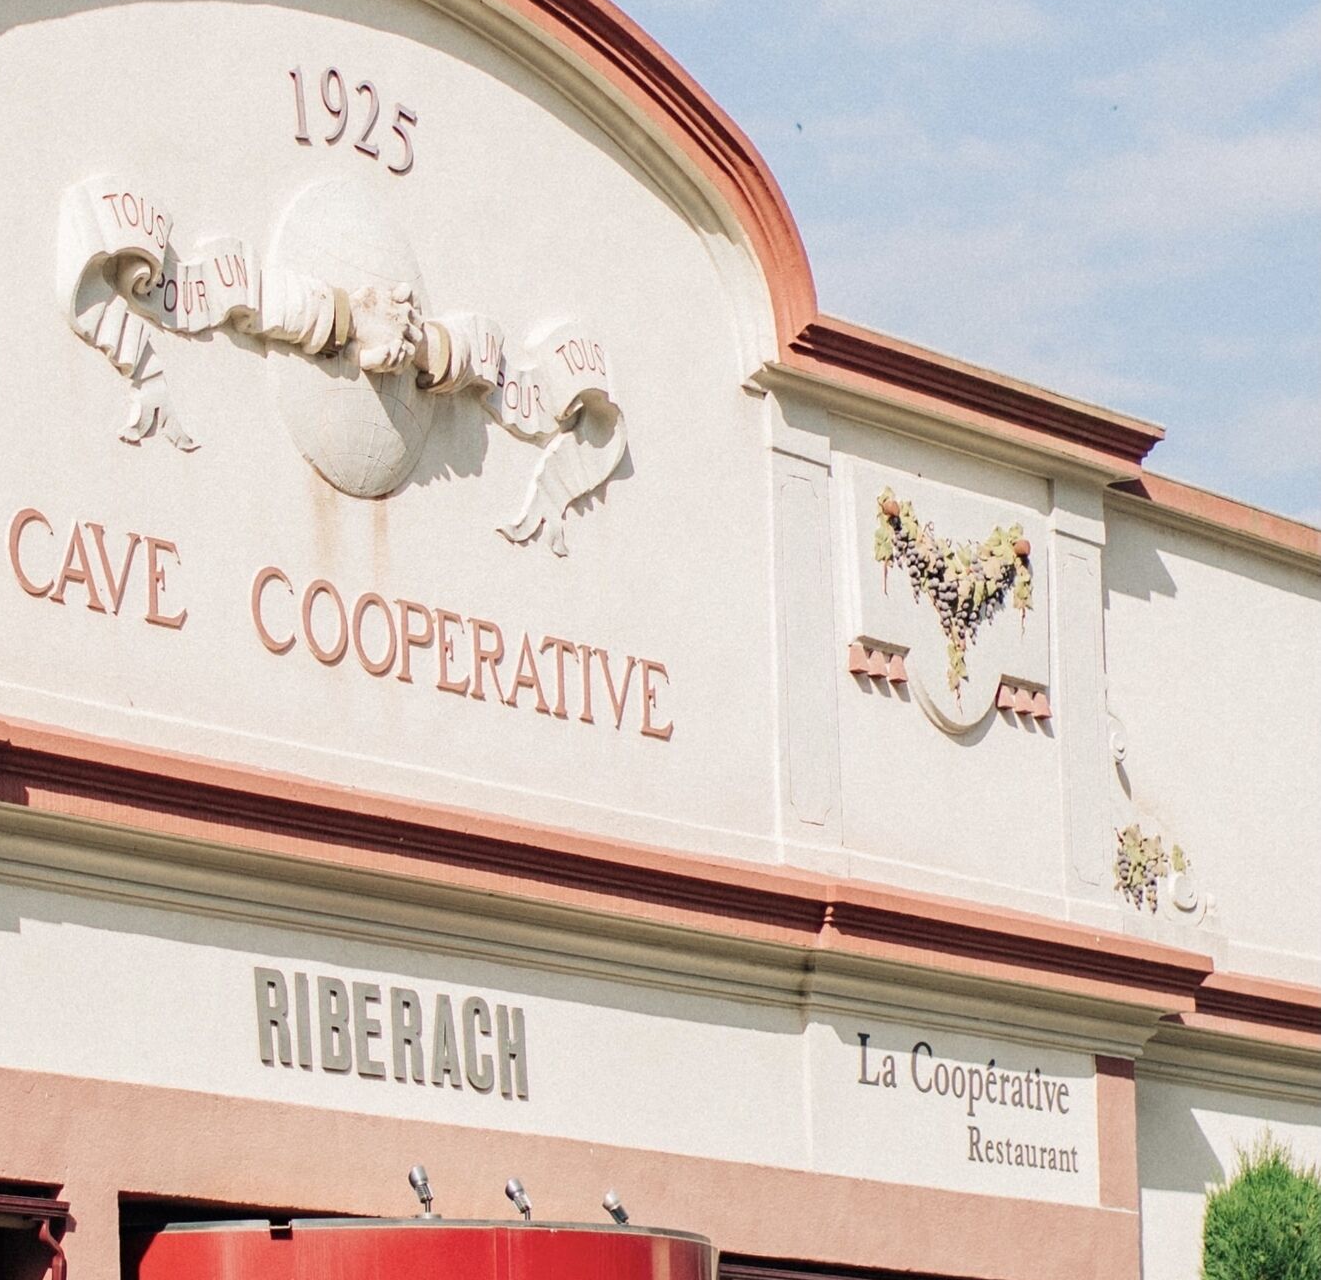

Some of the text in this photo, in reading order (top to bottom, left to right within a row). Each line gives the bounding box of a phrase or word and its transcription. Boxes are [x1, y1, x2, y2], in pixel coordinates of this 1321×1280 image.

[289, 65, 419, 176] 1925
[102, 192, 166, 249] TOUS
[214, 254, 248, 290] UN
[555, 338, 607, 376] TOUS
[9, 508, 674, 742] CAVE COOPERATIVE
[254, 966, 529, 1101] RIBERACH
[857, 1032, 1070, 1117] La Coopérative
[968, 1125, 1079, 1173] Restaurant
